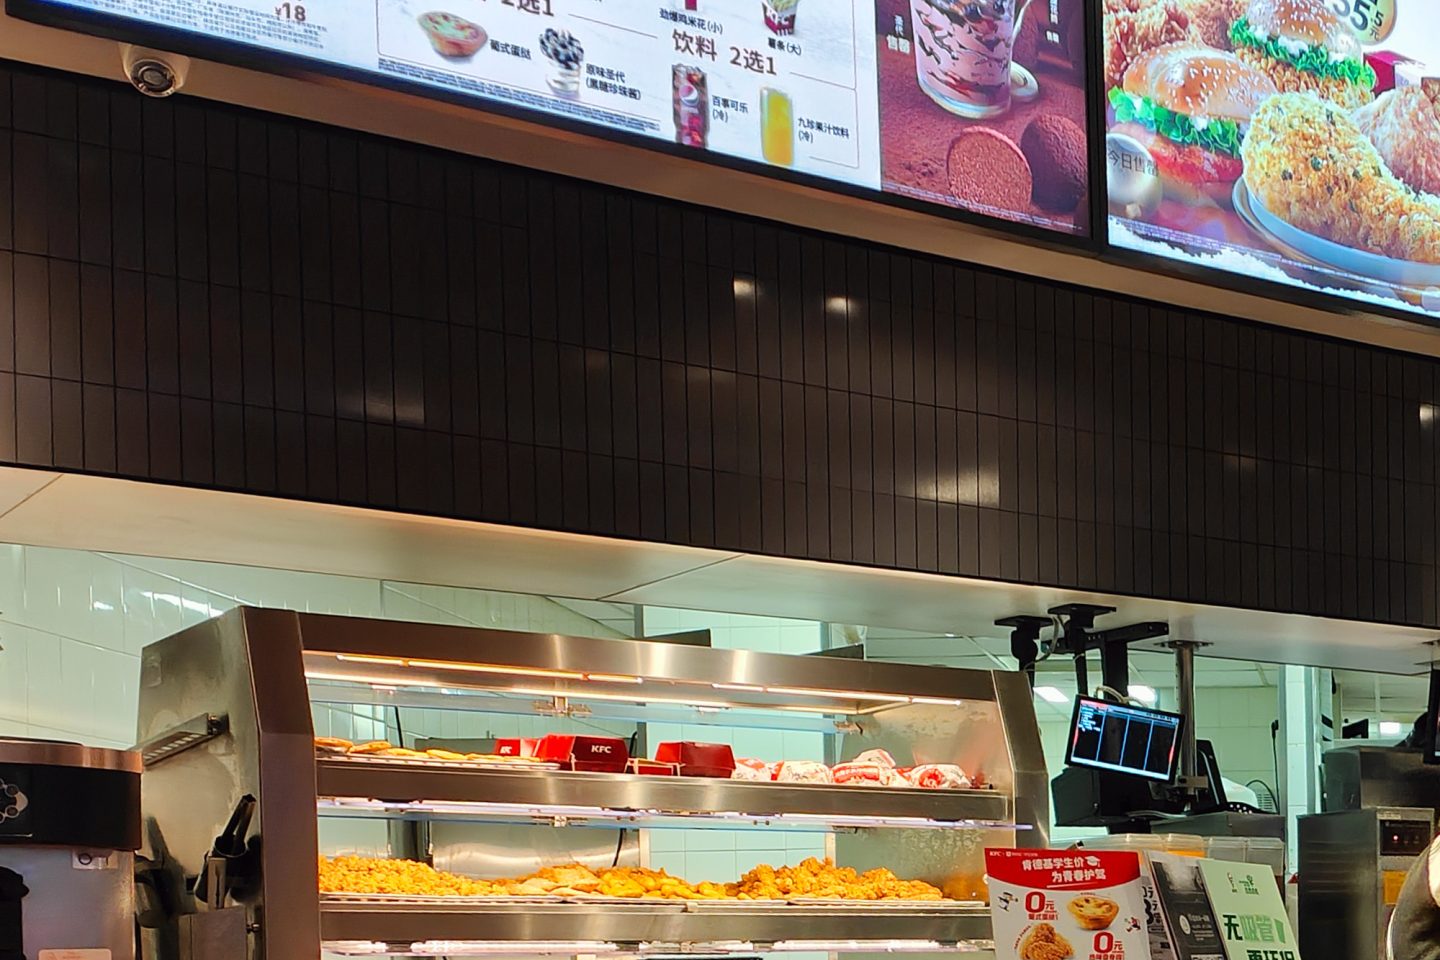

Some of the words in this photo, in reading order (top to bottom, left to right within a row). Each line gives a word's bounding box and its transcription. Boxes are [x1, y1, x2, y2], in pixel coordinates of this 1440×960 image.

[275, 2, 305, 21] ¥18
[672, 29, 718, 62] 饮料
[729, 46, 777, 76] 2选1
[767, 37, 802, 56] 薯条(大)
[586, 63, 626, 84] 原味圣代
[712, 95, 749, 114] 百事可乐
[712, 108, 729, 123] (冷)
[798, 117, 850, 139] 九珍果汁饮料
[798, 131, 814, 144] (冷)
[592, 745, 612, 754] KFC
